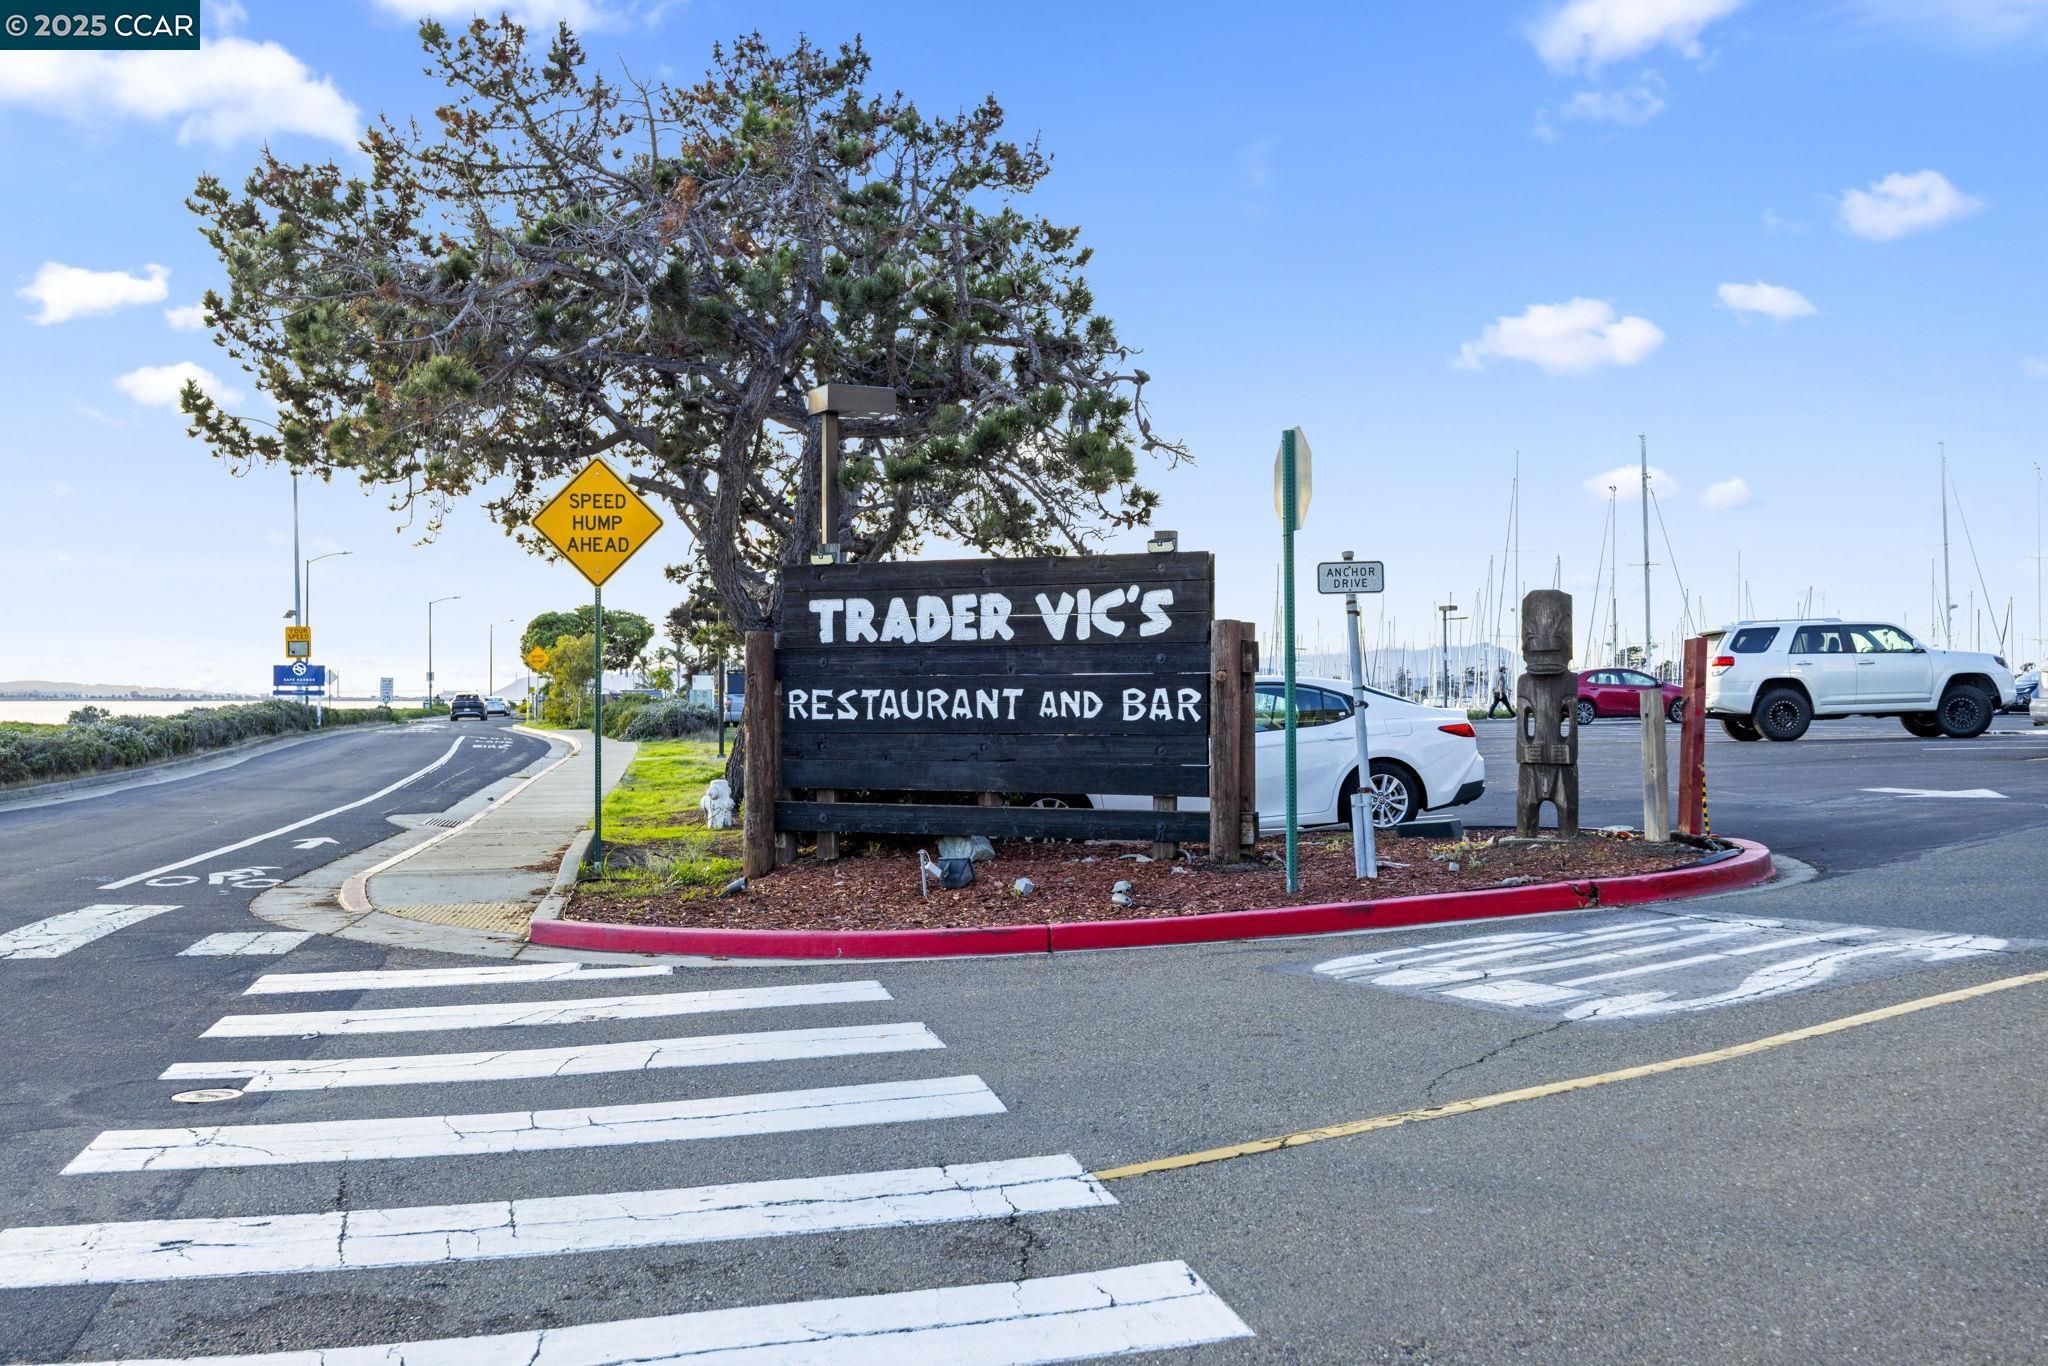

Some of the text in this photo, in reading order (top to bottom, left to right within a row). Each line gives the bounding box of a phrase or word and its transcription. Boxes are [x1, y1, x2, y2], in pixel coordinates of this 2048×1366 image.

[569, 493, 626, 509] SPEED
[572, 515, 623, 531] HUMP
[566, 537, 629, 553] AHEAD
[1326, 567, 1375, 577] ANCHOR
[1333, 578, 1368, 588] DRIVE
[808, 584, 1174, 644] TRADER VIC'S
[788, 687, 1202, 722] RESTAURANT AND BAR
